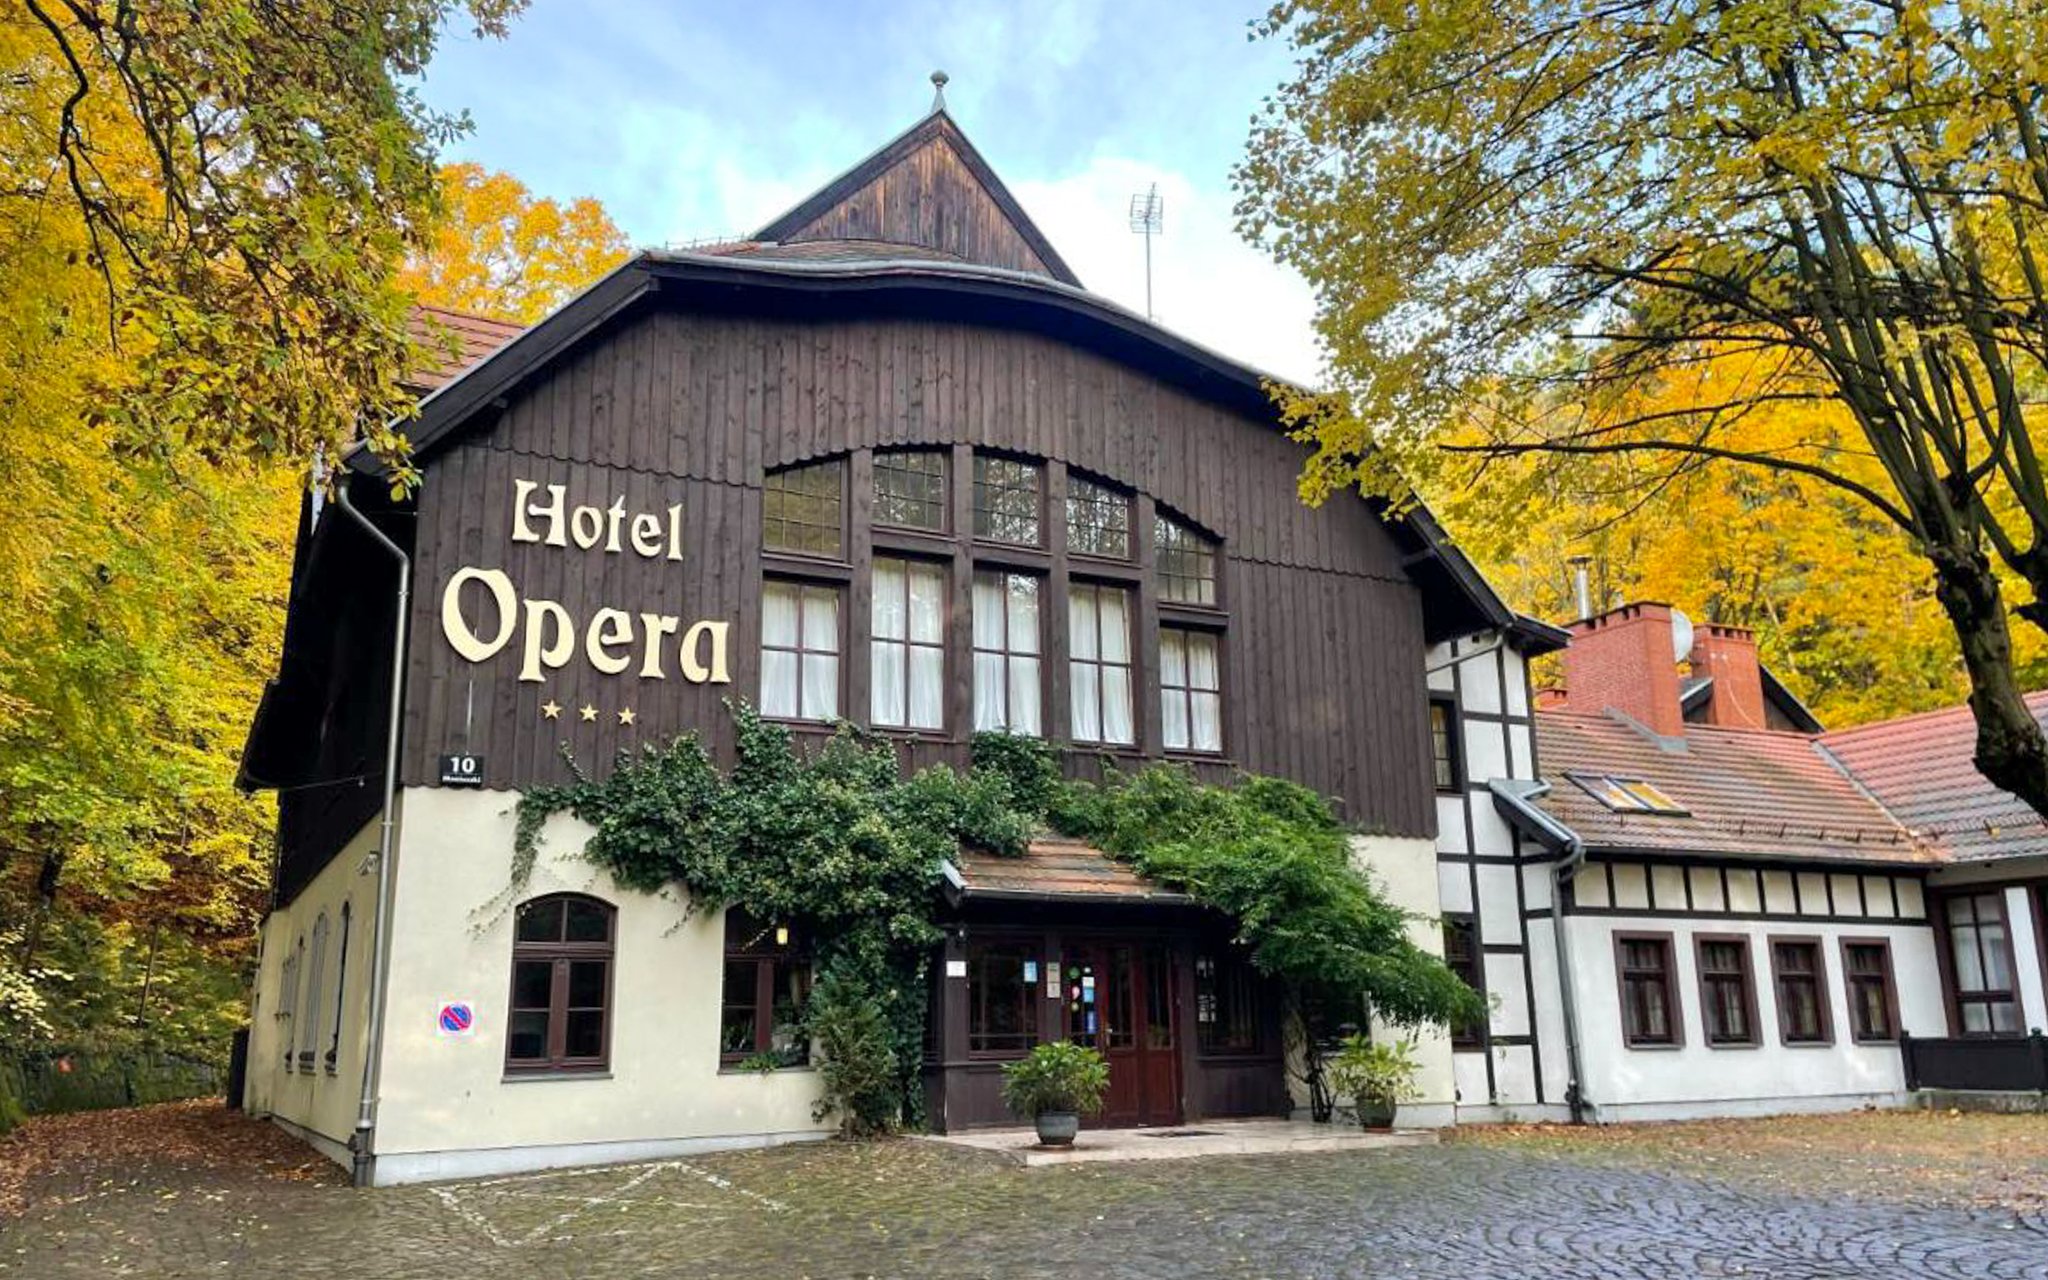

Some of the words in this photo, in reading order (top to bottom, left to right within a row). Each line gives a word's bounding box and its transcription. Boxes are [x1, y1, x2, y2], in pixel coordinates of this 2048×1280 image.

[512, 479, 683, 561] Hotel
[442, 566, 731, 683] Opera
[450, 756, 476, 773] 10
